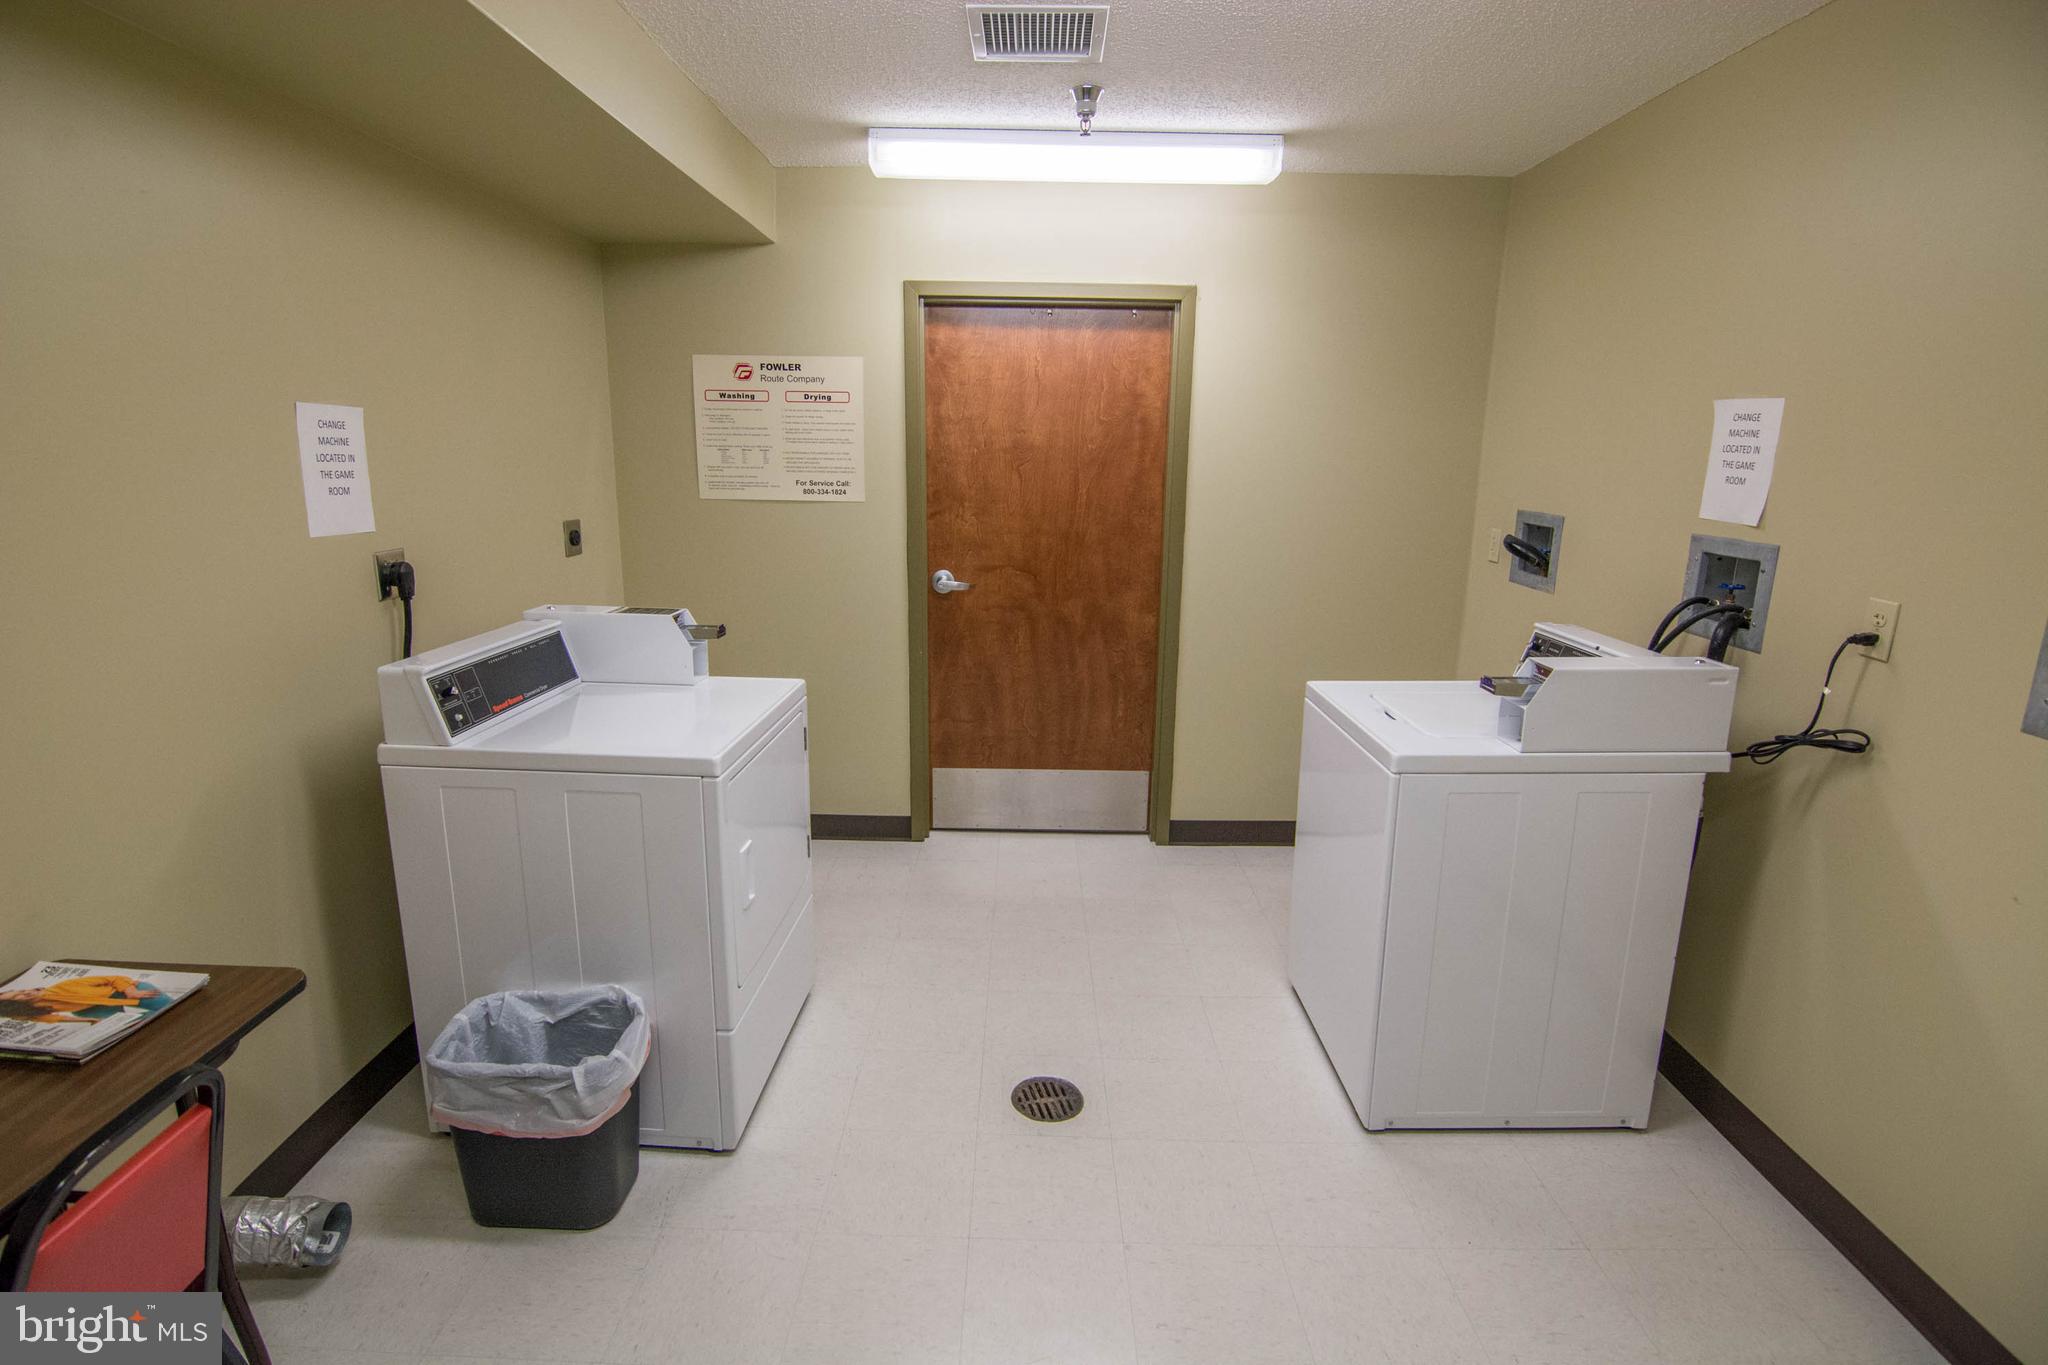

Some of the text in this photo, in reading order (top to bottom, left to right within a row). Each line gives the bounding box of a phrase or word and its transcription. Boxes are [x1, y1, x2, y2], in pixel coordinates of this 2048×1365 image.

[760, 363, 802, 372] FOWLER
[760, 374, 825, 384] Route Company
[719, 392, 756, 400] Washing
[804, 394, 832, 402] Drying
[1733, 412, 1762, 422] CHANGE
[318, 420, 346, 430] CHANGE
[1728, 429, 1760, 438] MACHINE
[318, 436, 350, 446] MACHINE
[1722, 444, 1761, 454] LOCATED IN
[316, 454, 356, 463] LOCATED IN
[1722, 460, 1756, 470] THE GAME
[320, 470, 356, 479] THE GAME
[795, 479, 808, 487] For
[1725, 476, 1746, 485] ROOM
[328, 486, 350, 496] ROOM
